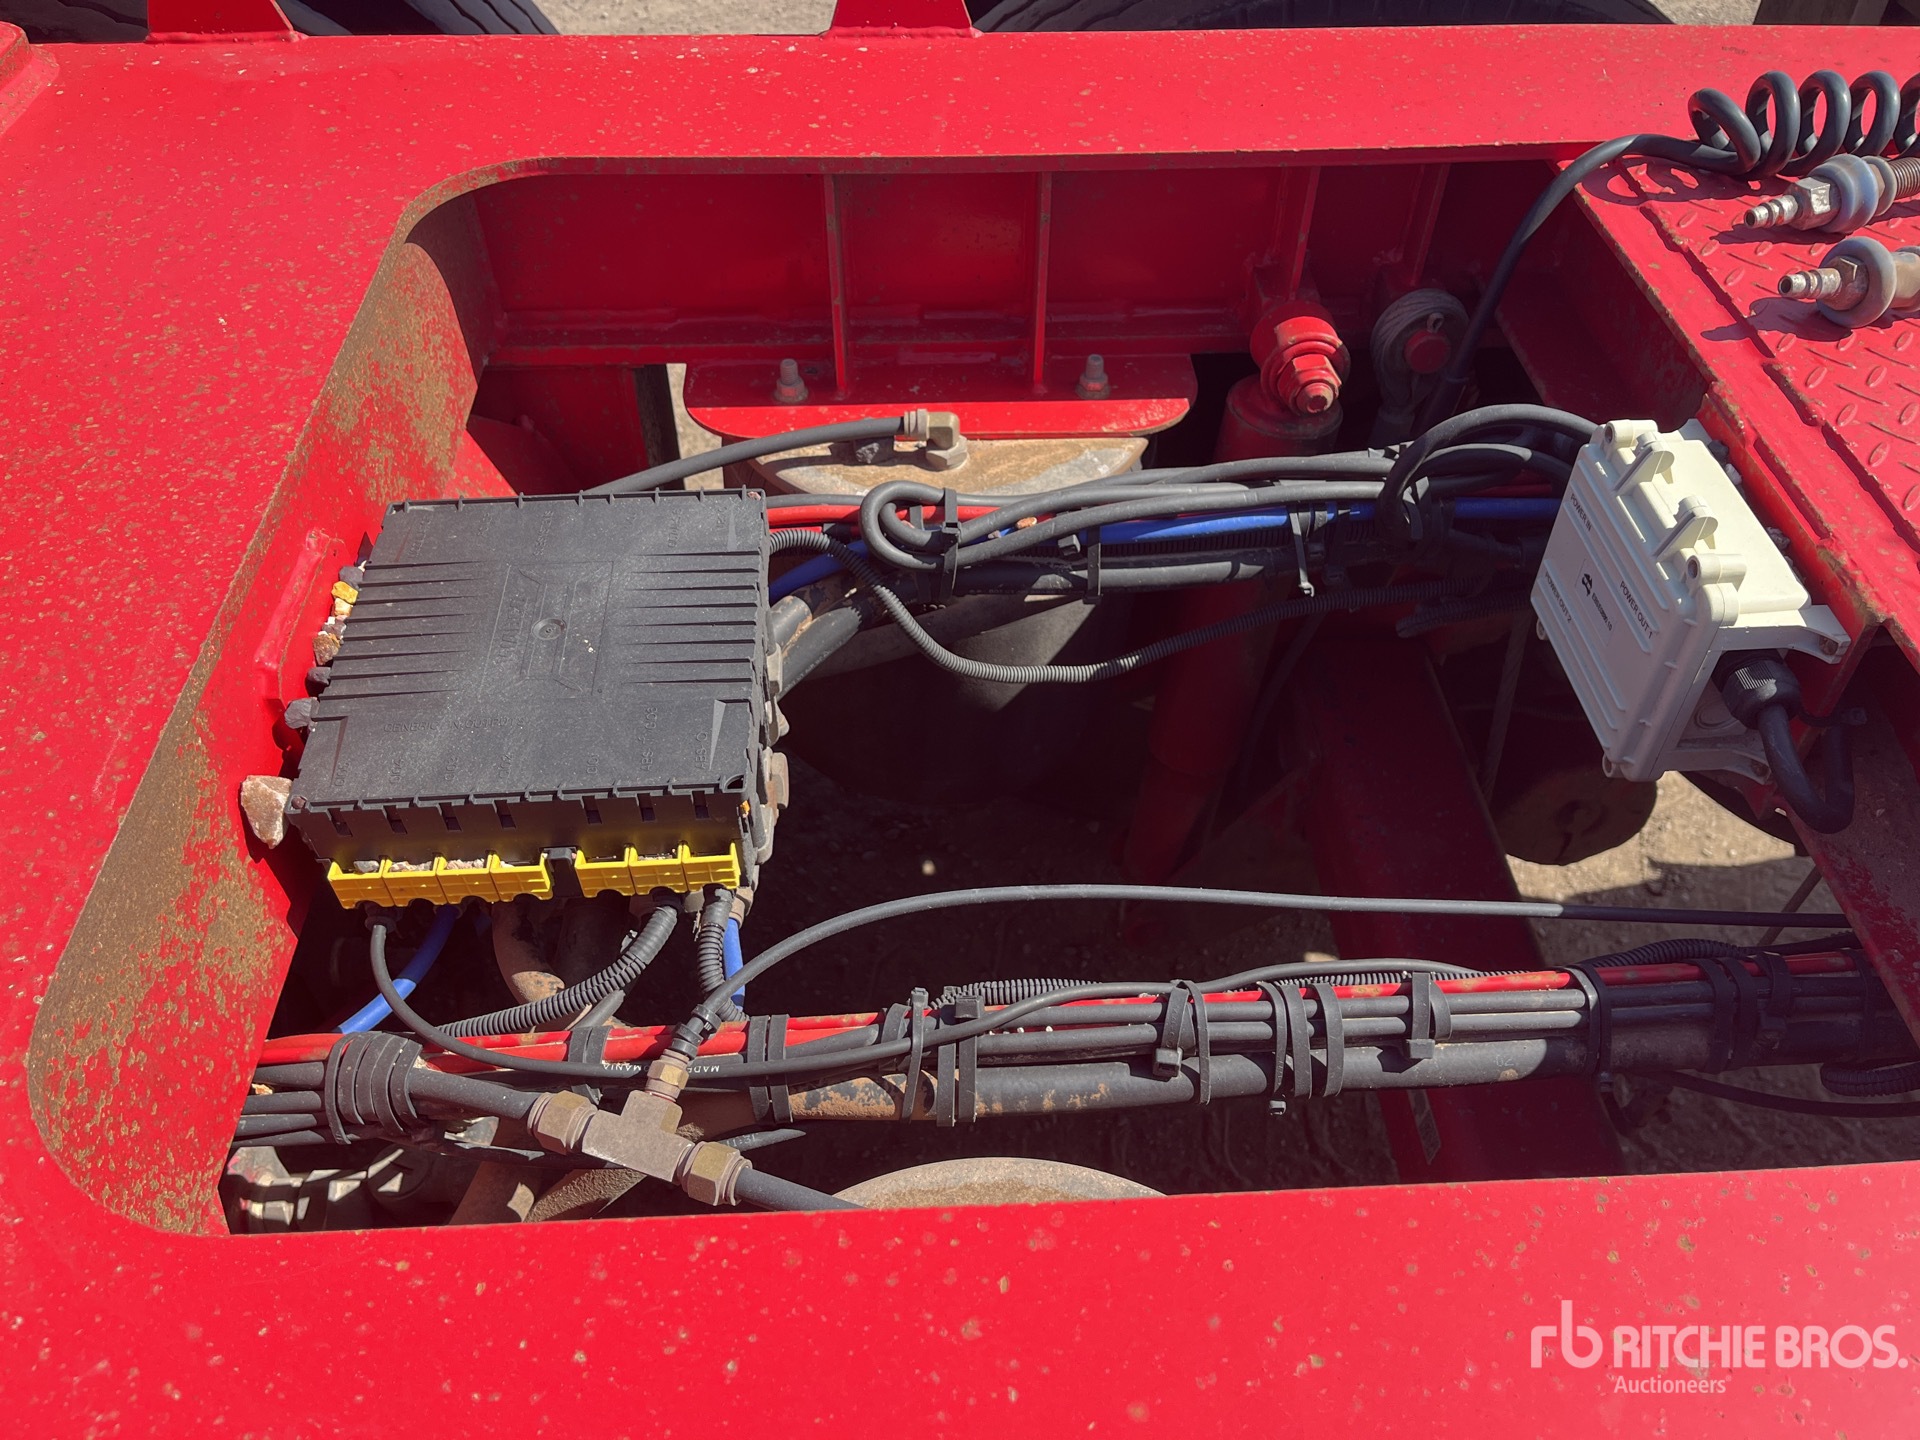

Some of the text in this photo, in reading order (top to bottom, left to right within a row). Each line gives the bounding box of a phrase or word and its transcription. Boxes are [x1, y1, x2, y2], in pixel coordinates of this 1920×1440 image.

[1570, 493, 1587, 523] POWER
[1545, 571, 1560, 602] POWER
[1558, 597, 1570, 617] OUT
[1620, 580, 1638, 615] POWER
[1637, 612, 1650, 631] OUT
[383, 721, 440, 732] GENERIC
